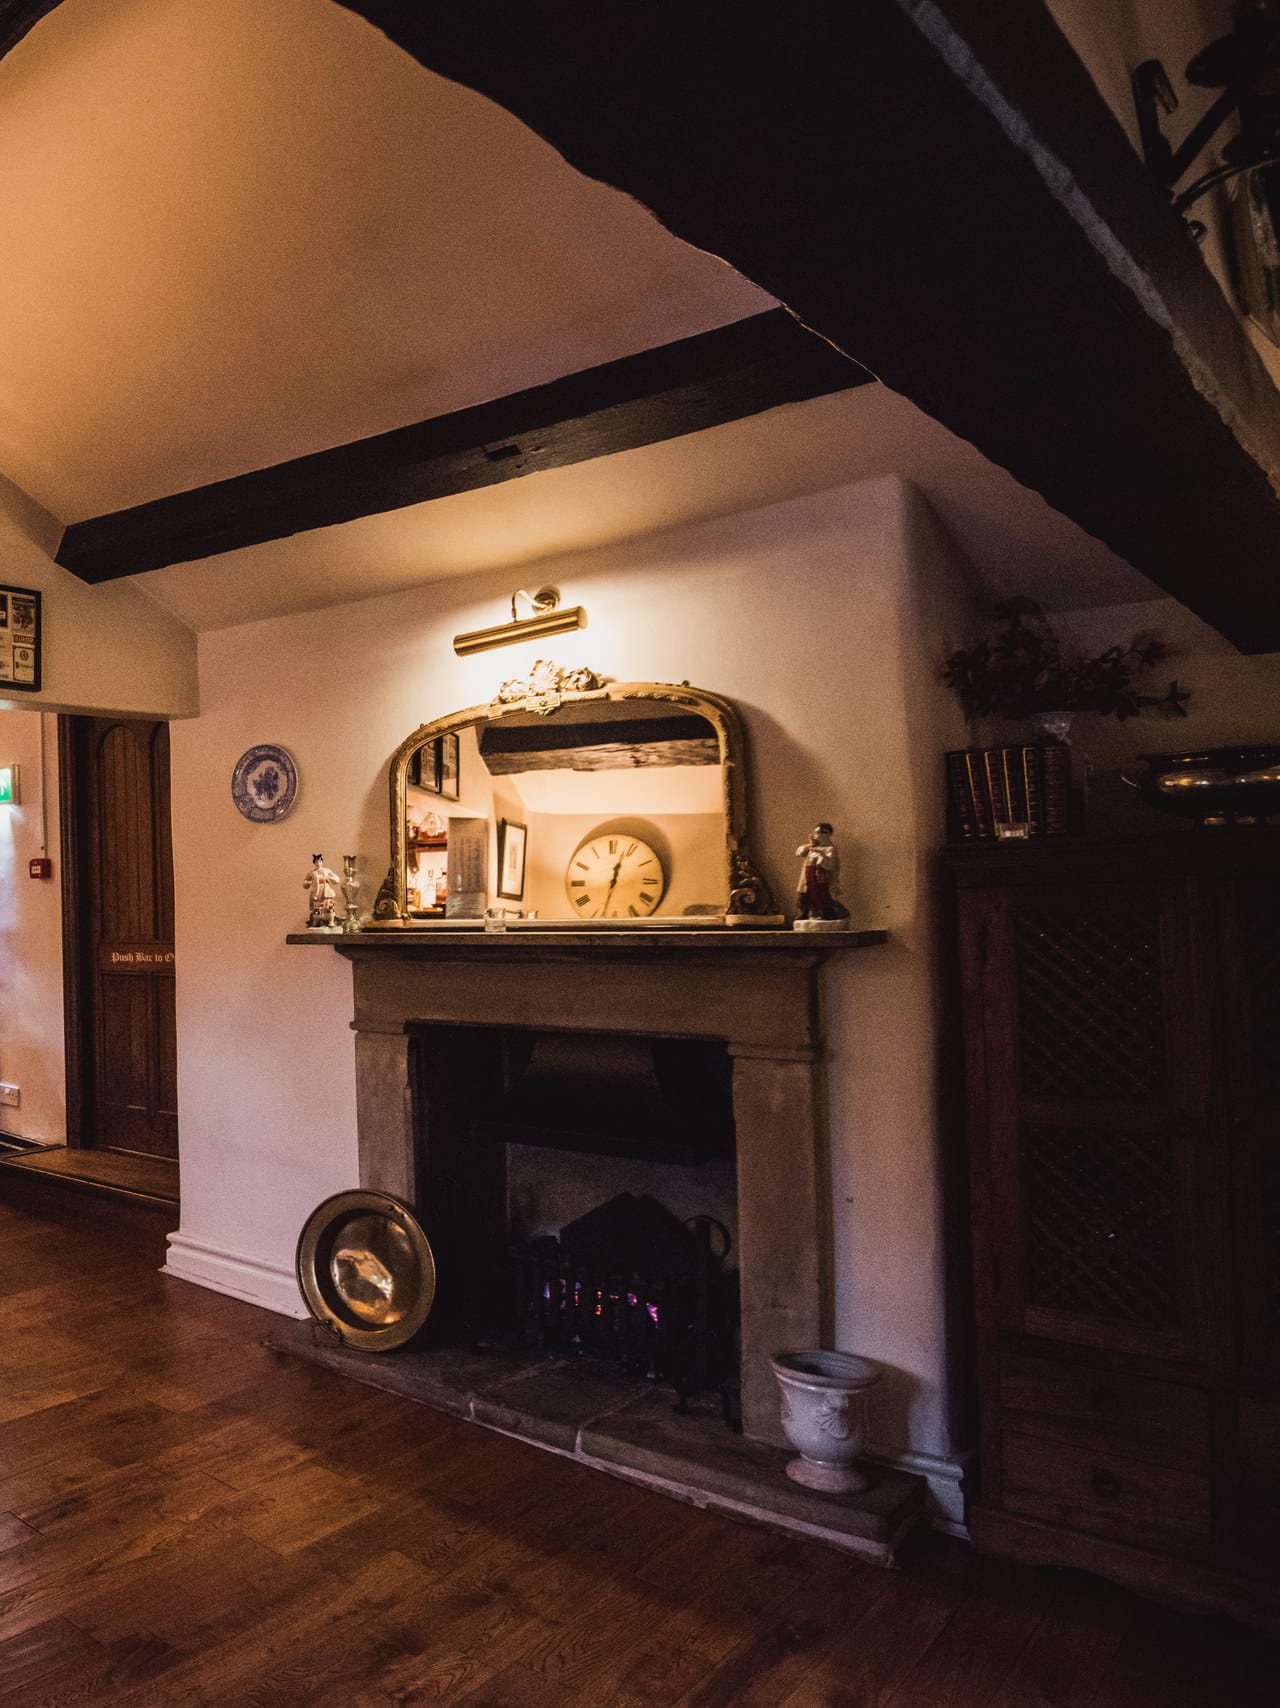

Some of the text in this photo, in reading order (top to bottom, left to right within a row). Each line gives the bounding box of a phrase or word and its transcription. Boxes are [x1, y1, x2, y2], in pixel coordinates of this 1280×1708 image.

[112, 952, 134, 963] Push
[136, 952, 153, 963] Bar
[154, 954, 163, 962] to
